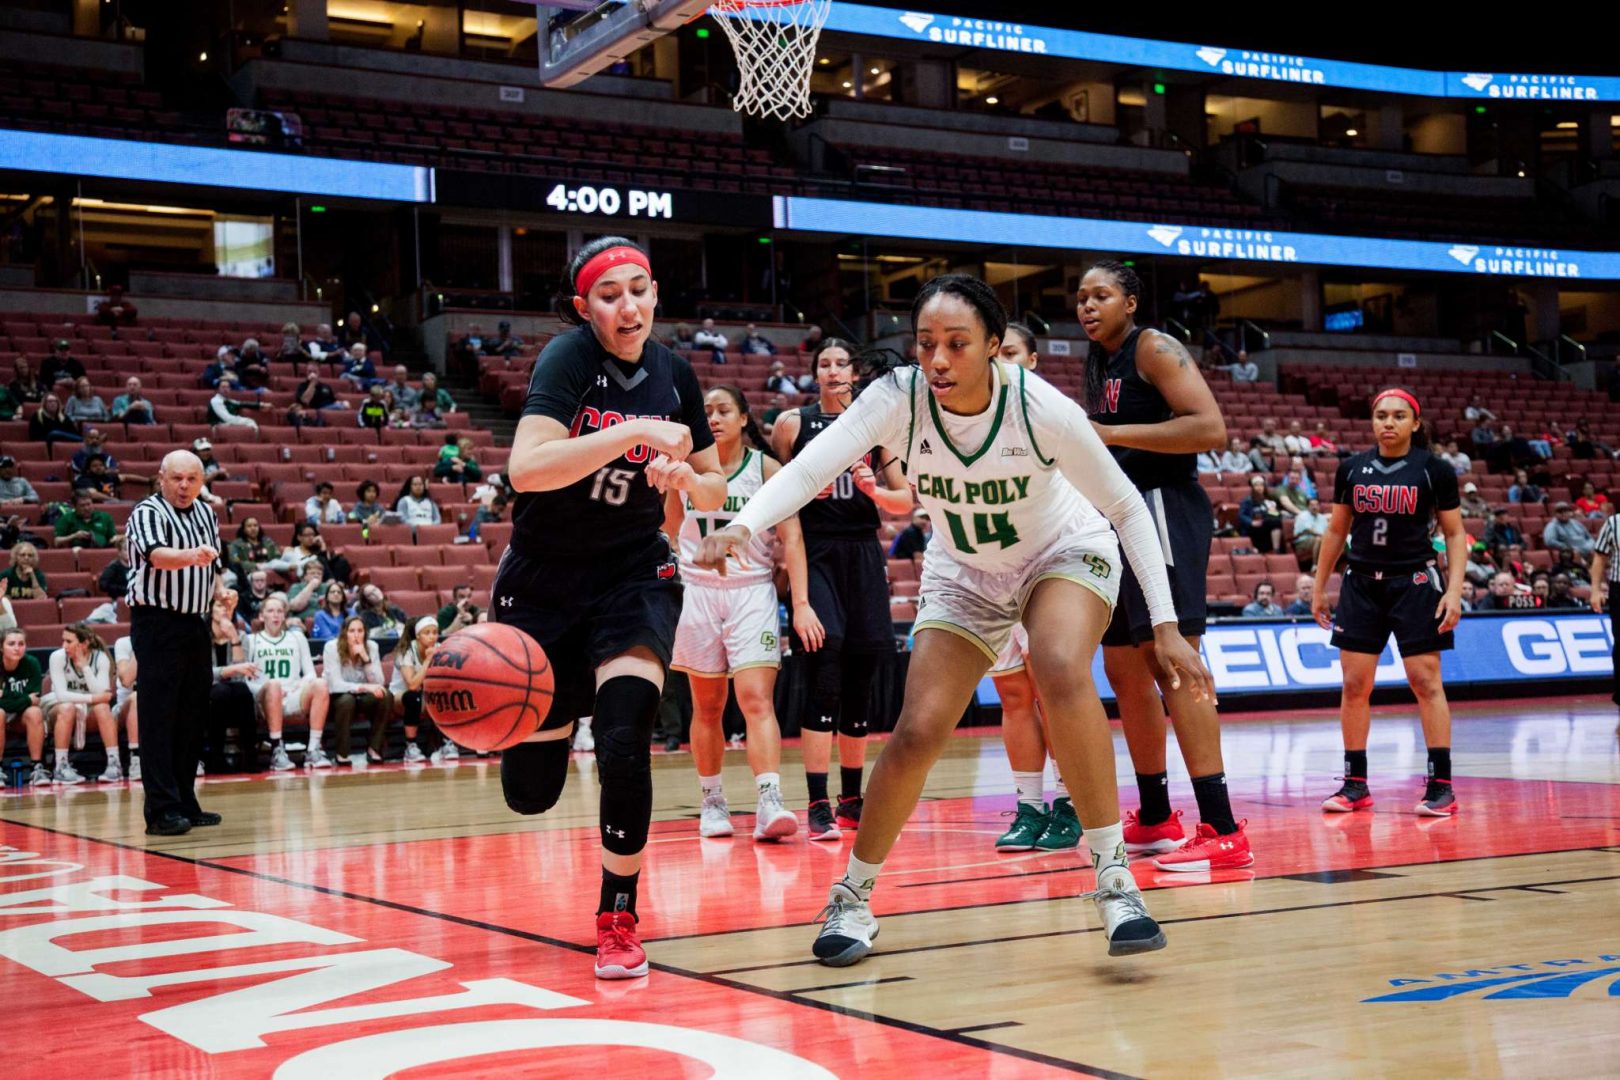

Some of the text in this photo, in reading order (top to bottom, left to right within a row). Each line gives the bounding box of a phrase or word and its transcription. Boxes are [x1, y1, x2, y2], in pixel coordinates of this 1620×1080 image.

[952, 17, 1023, 34] PACIFIC
[929, 27, 1047, 53] SURFLINER
[1242, 51, 1304, 67] PACIFIC
[1222, 60, 1326, 84] SURFLINER
[1510, 75, 1575, 85] PACIFIC
[1489, 84, 1598, 100] SURFLINER
[546, 184, 673, 219] 4:00 PM
[1201, 228, 1273, 243] PACIFIC
[1178, 239, 1298, 261] SURFLINER
[1495, 247, 1558, 260] PACIFIC
[1475, 258, 1579, 277] SURFLINER
[591, 467, 638, 504] 15
[918, 474, 1031, 505] CAL POLY
[1353, 484, 1418, 514] CSUN
[943, 509, 1021, 554] 14
[1373, 518, 1388, 546] 2
[265, 659, 290, 679] 40
